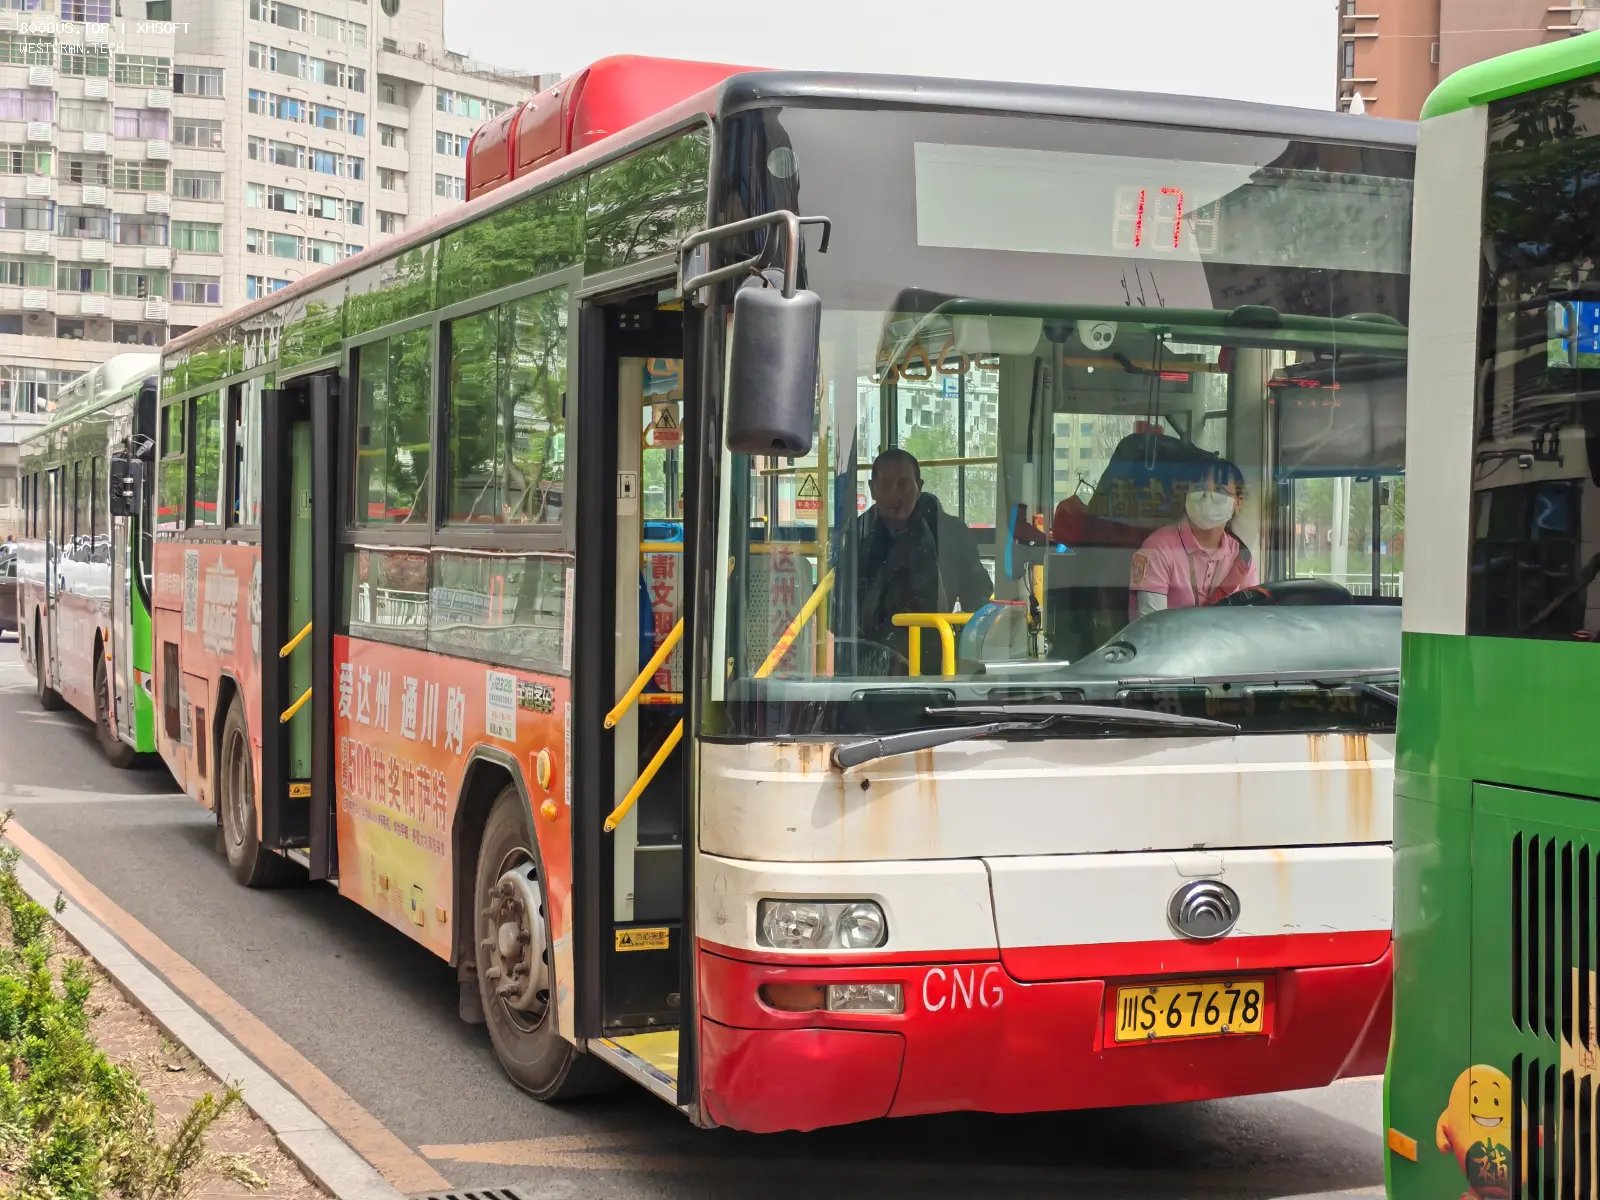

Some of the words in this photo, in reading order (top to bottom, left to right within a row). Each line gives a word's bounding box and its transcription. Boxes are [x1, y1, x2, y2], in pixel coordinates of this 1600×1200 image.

[1134, 187, 1184, 248] 17
[338, 662, 391, 733] 爱达州
[401, 675, 465, 754] 通川购
[922, 966, 1004, 1011] CNG
